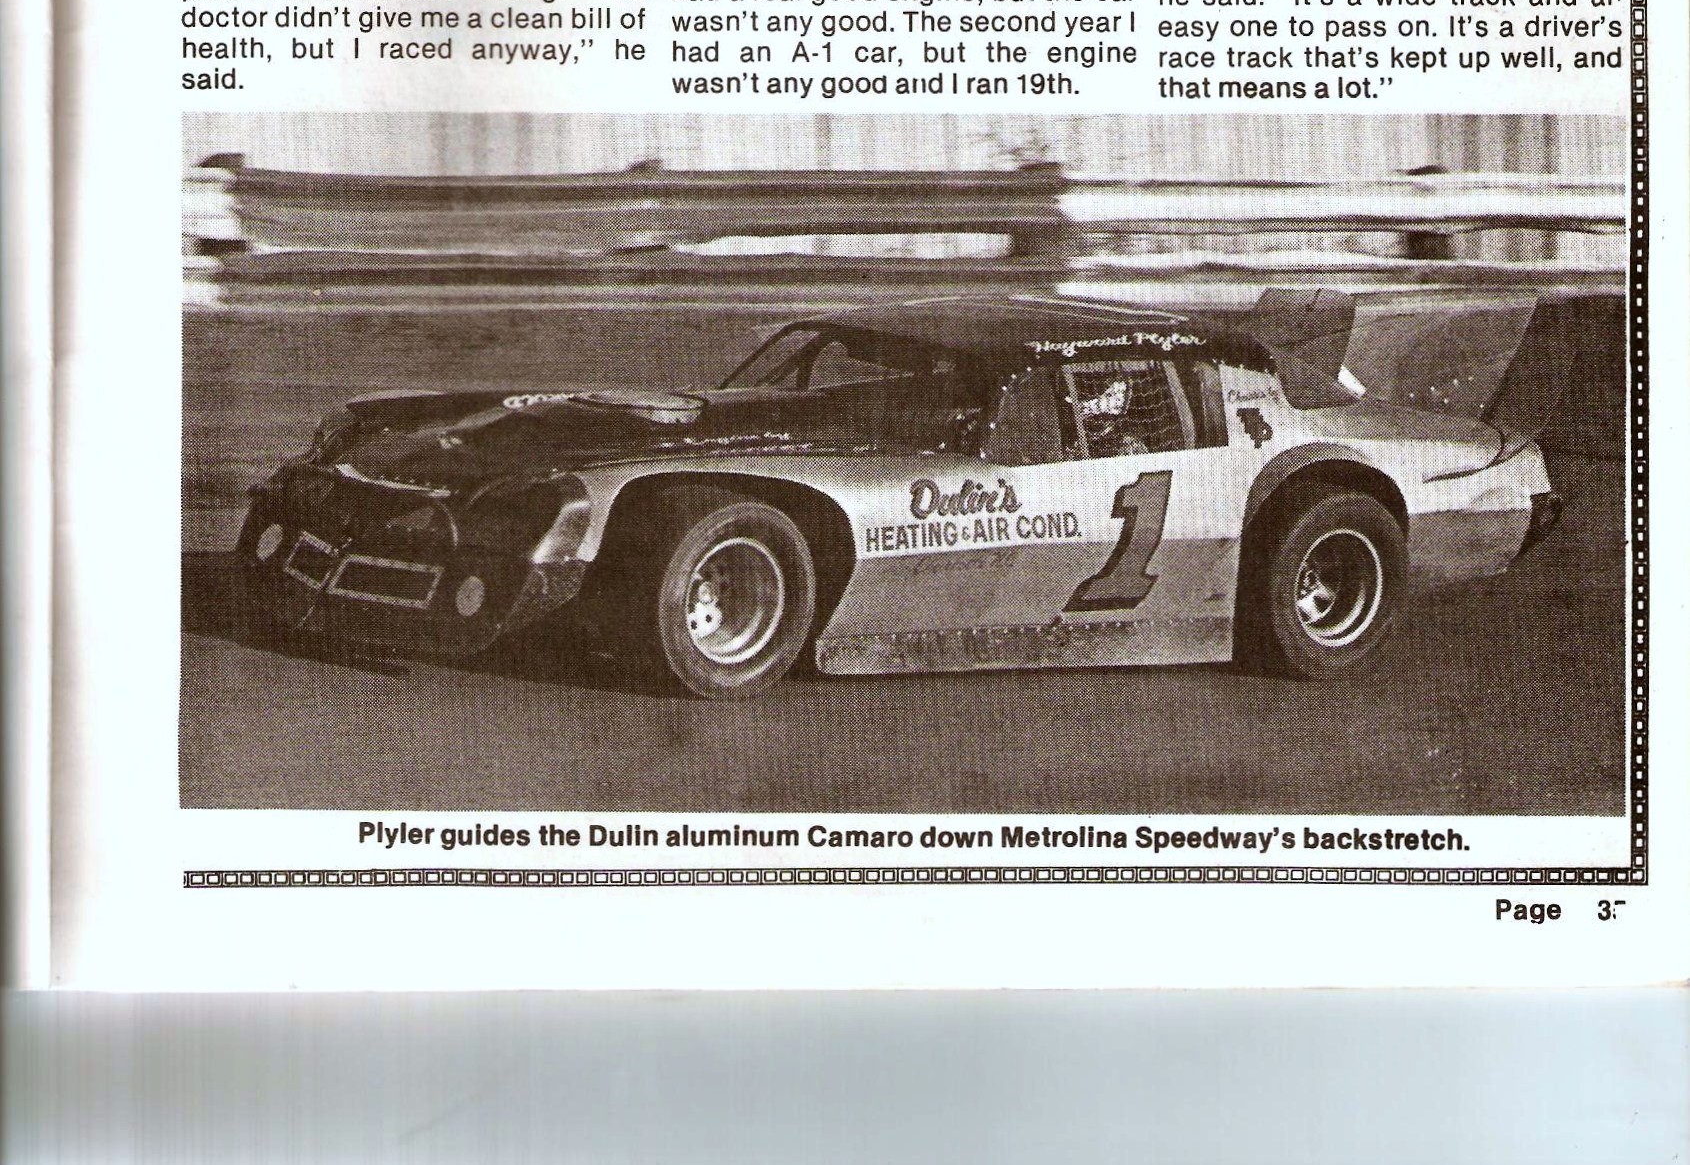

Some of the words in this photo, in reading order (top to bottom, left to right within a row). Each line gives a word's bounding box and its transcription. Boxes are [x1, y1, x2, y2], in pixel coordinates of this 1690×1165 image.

[181, 67, 244, 90] said.
[910, 478, 1022, 520] Dulin's
[866, 521, 958, 553] HEATING
[973, 517, 1010, 544] AIR
[1016, 512, 1082, 539] COND.
[1062, 470, 1174, 612] 1
[359, 821, 435, 850] Plyler
[440, 823, 531, 851] guides
[538, 824, 581, 847] the
[589, 824, 659, 848] Dulin
[665, 824, 800, 848] aluminum
[807, 825, 914, 849] Camaro
[919, 825, 993, 849] down
[1001, 825, 1128, 849] Metrolina
[1135, 825, 1296, 854] Speedway's
[1303, 826, 1470, 851] backstretch.
[1495, 898, 1562, 924] Page
